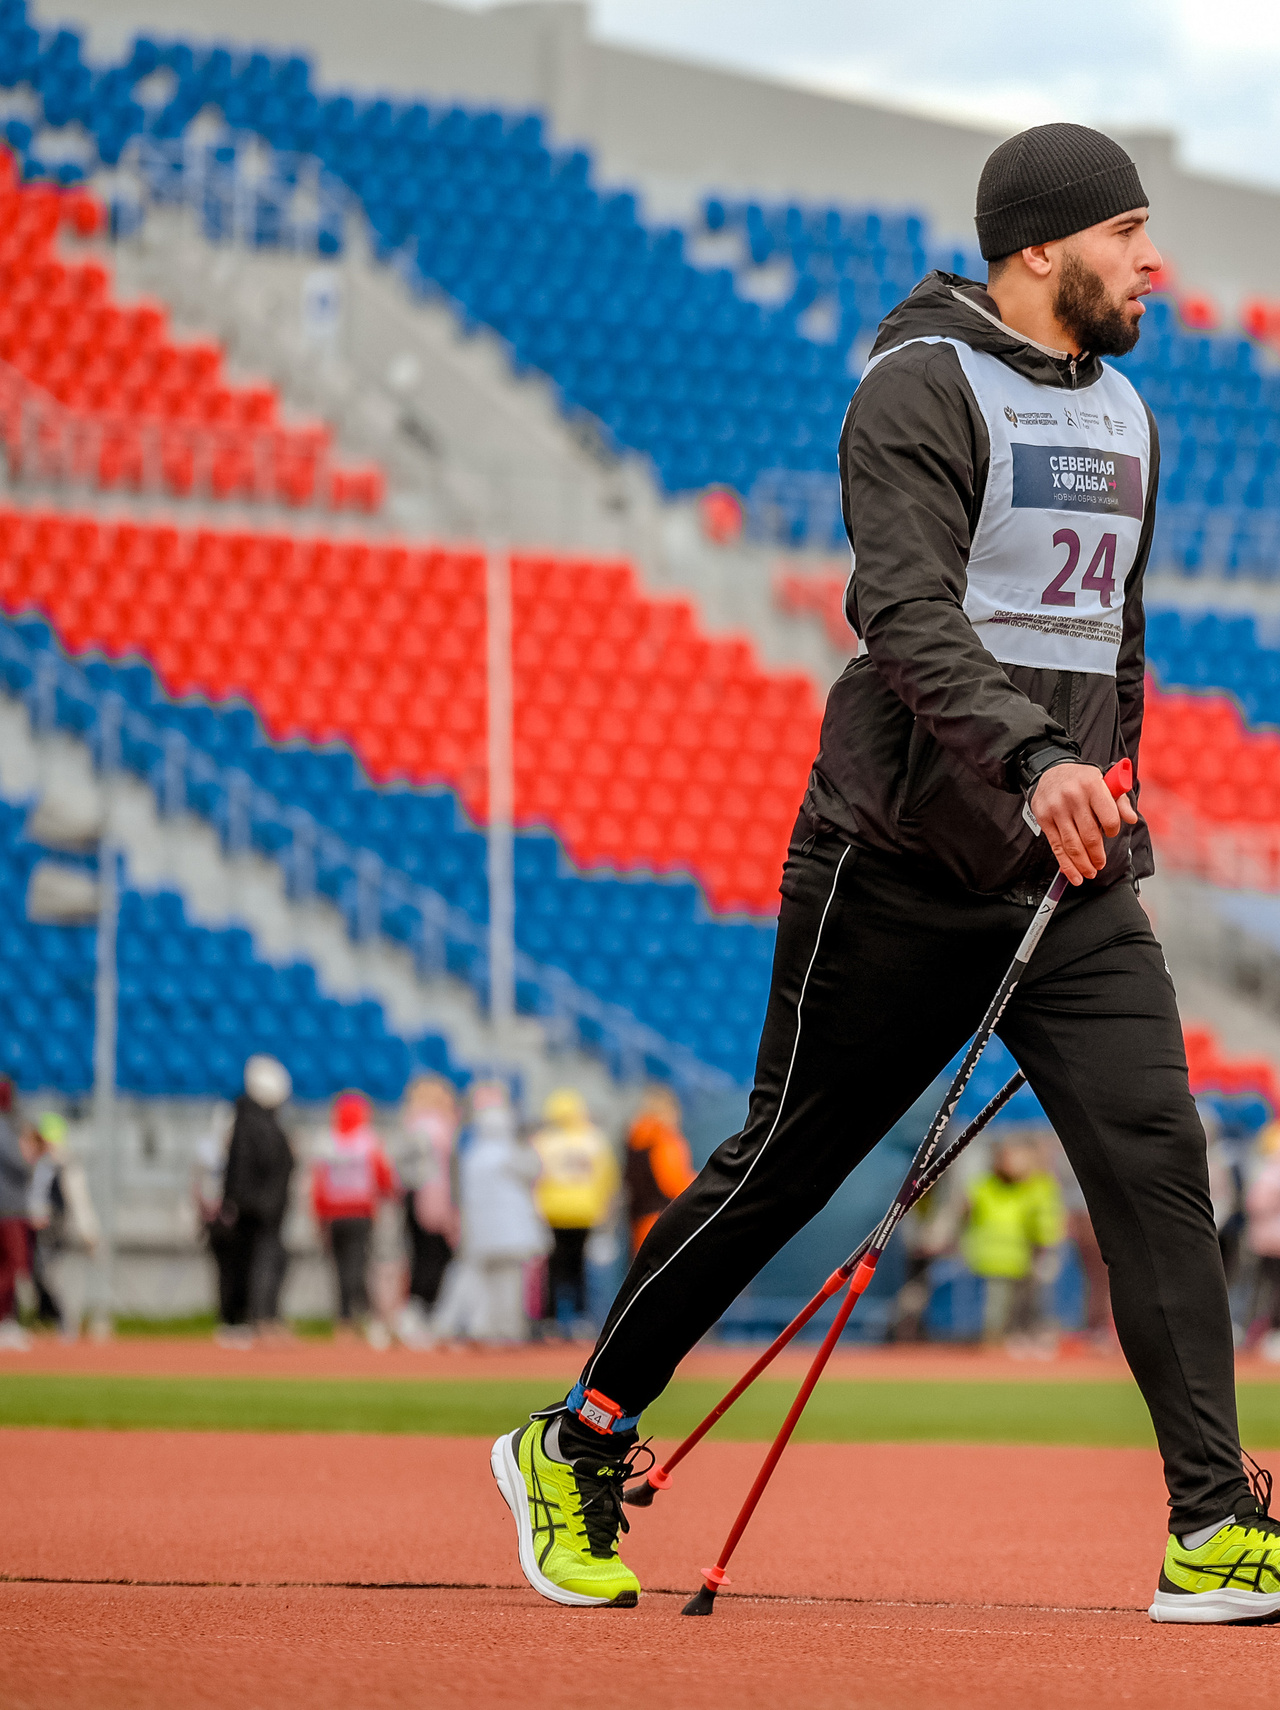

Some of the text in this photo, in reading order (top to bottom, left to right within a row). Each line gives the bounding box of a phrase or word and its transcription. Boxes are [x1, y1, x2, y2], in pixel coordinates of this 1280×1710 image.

[1050, 456, 1115, 475] СЕВЕРНАЯ
[1053, 493, 1077, 501] НОВЫЙ
[1041, 528, 1117, 608] 24
[586, 1409, 602, 1425] 24
